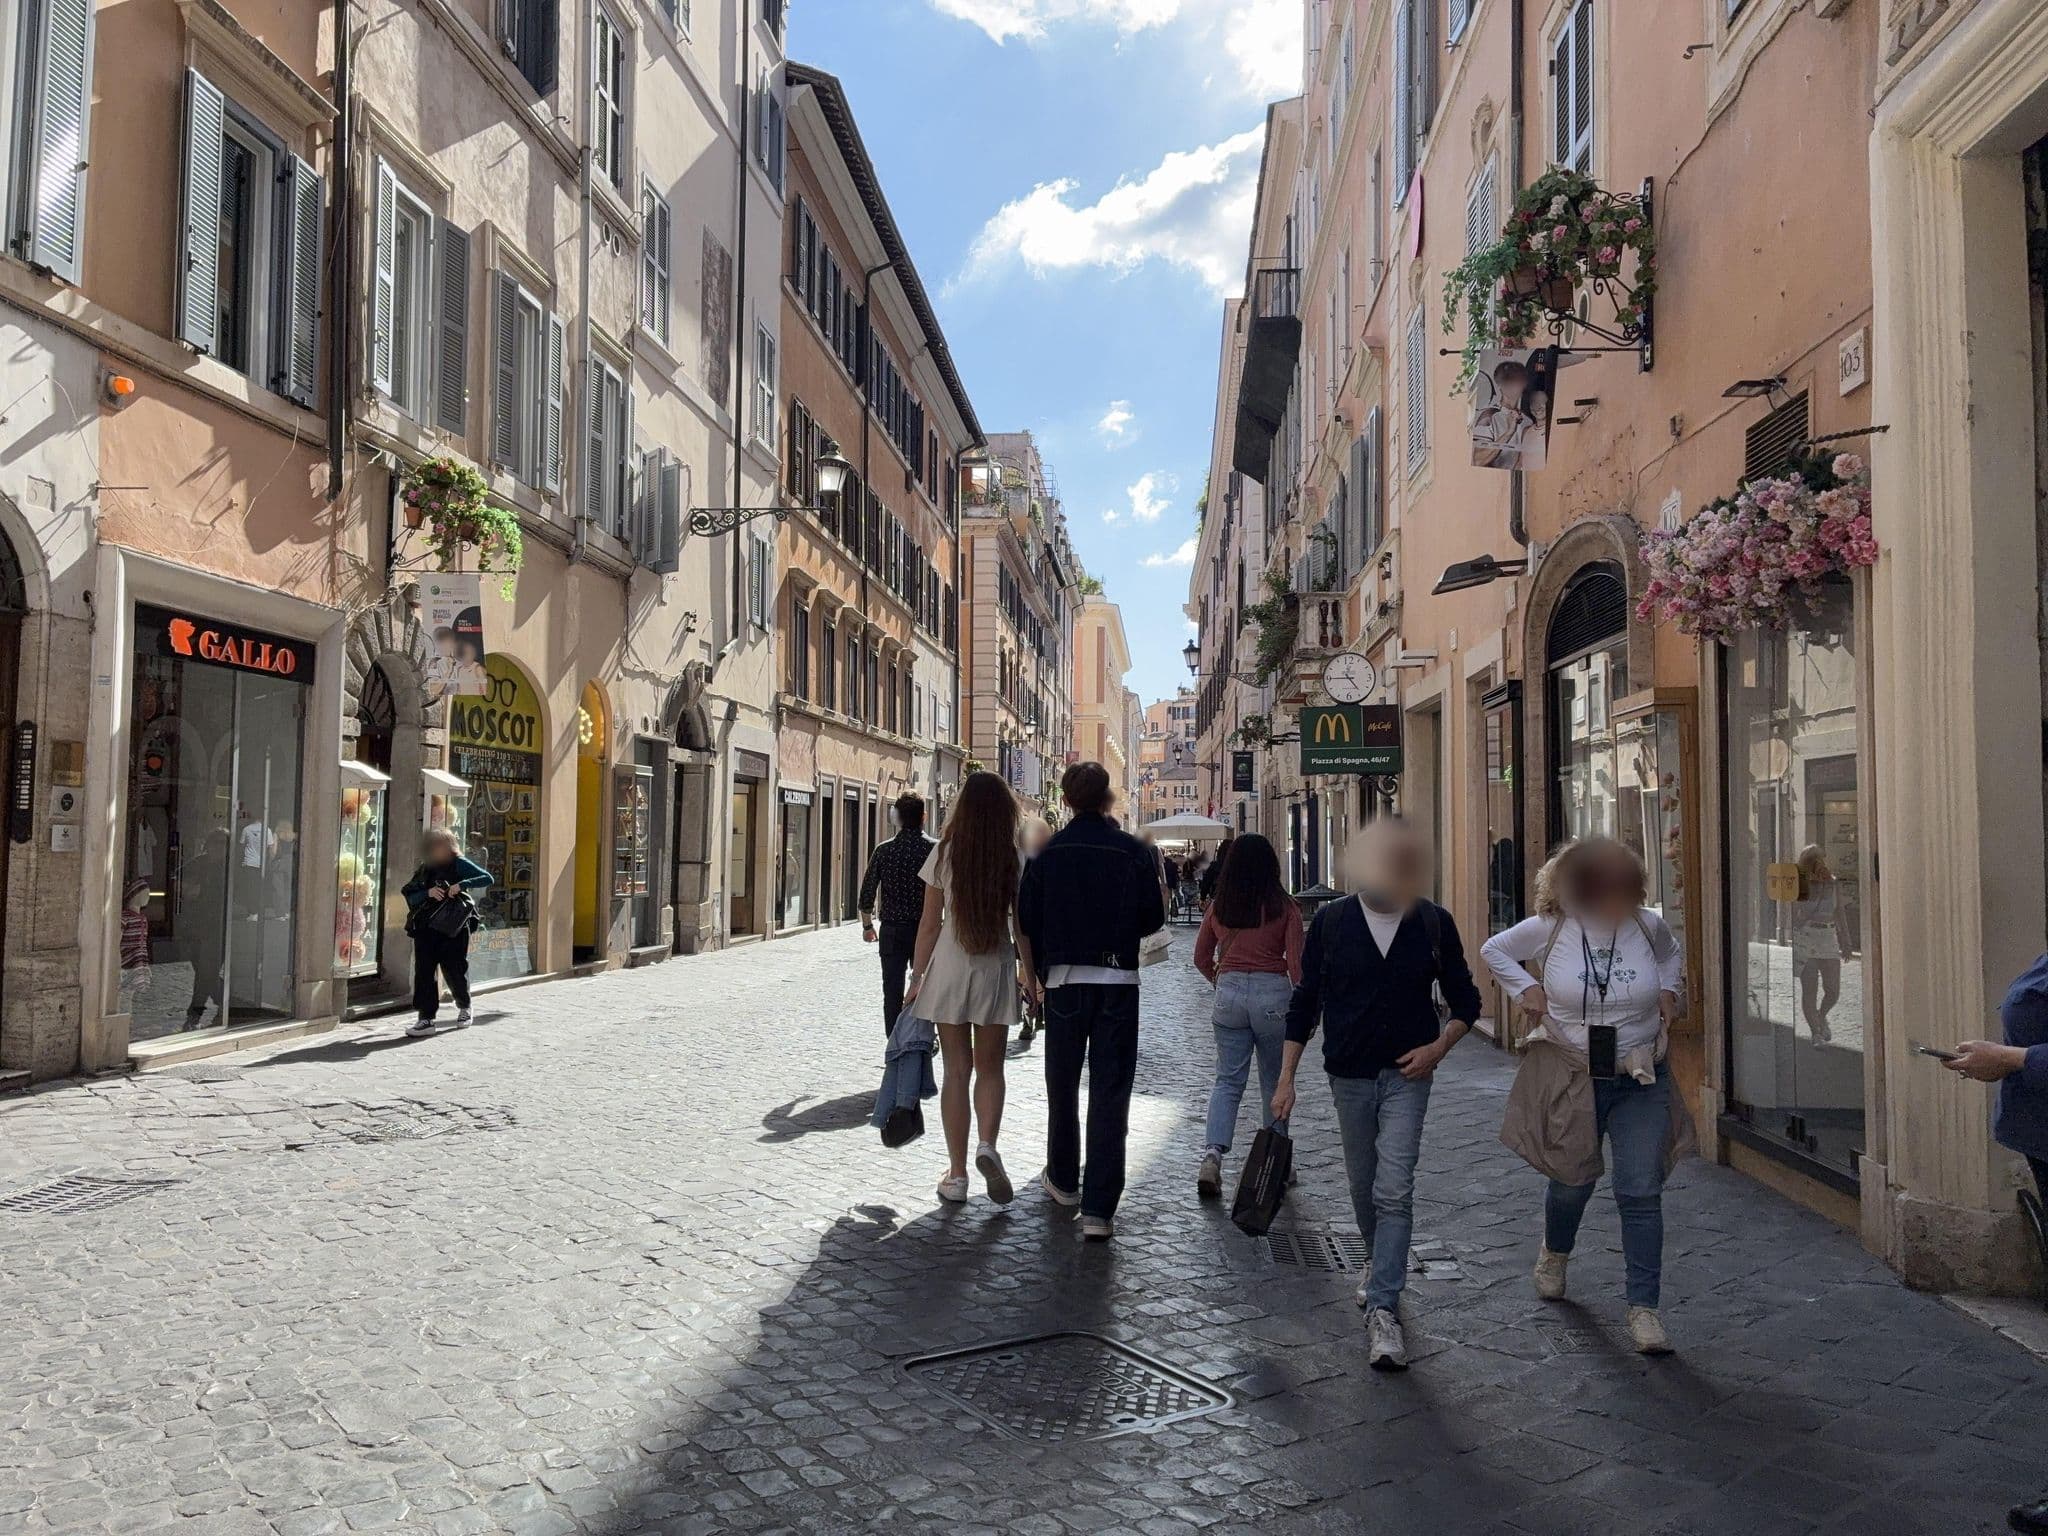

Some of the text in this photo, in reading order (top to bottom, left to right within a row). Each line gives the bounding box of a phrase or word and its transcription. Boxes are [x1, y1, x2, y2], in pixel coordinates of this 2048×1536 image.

[199, 630, 296, 675] GALLO
[1344, 656, 1354, 665] 12
[1366, 673, 1372, 682] 3
[1346, 692, 1352, 700] 6
[450, 701, 535, 748] MOSCOT
[1311, 757, 1334, 765] Piazza
[1342, 757, 1370, 765] Spagna,
